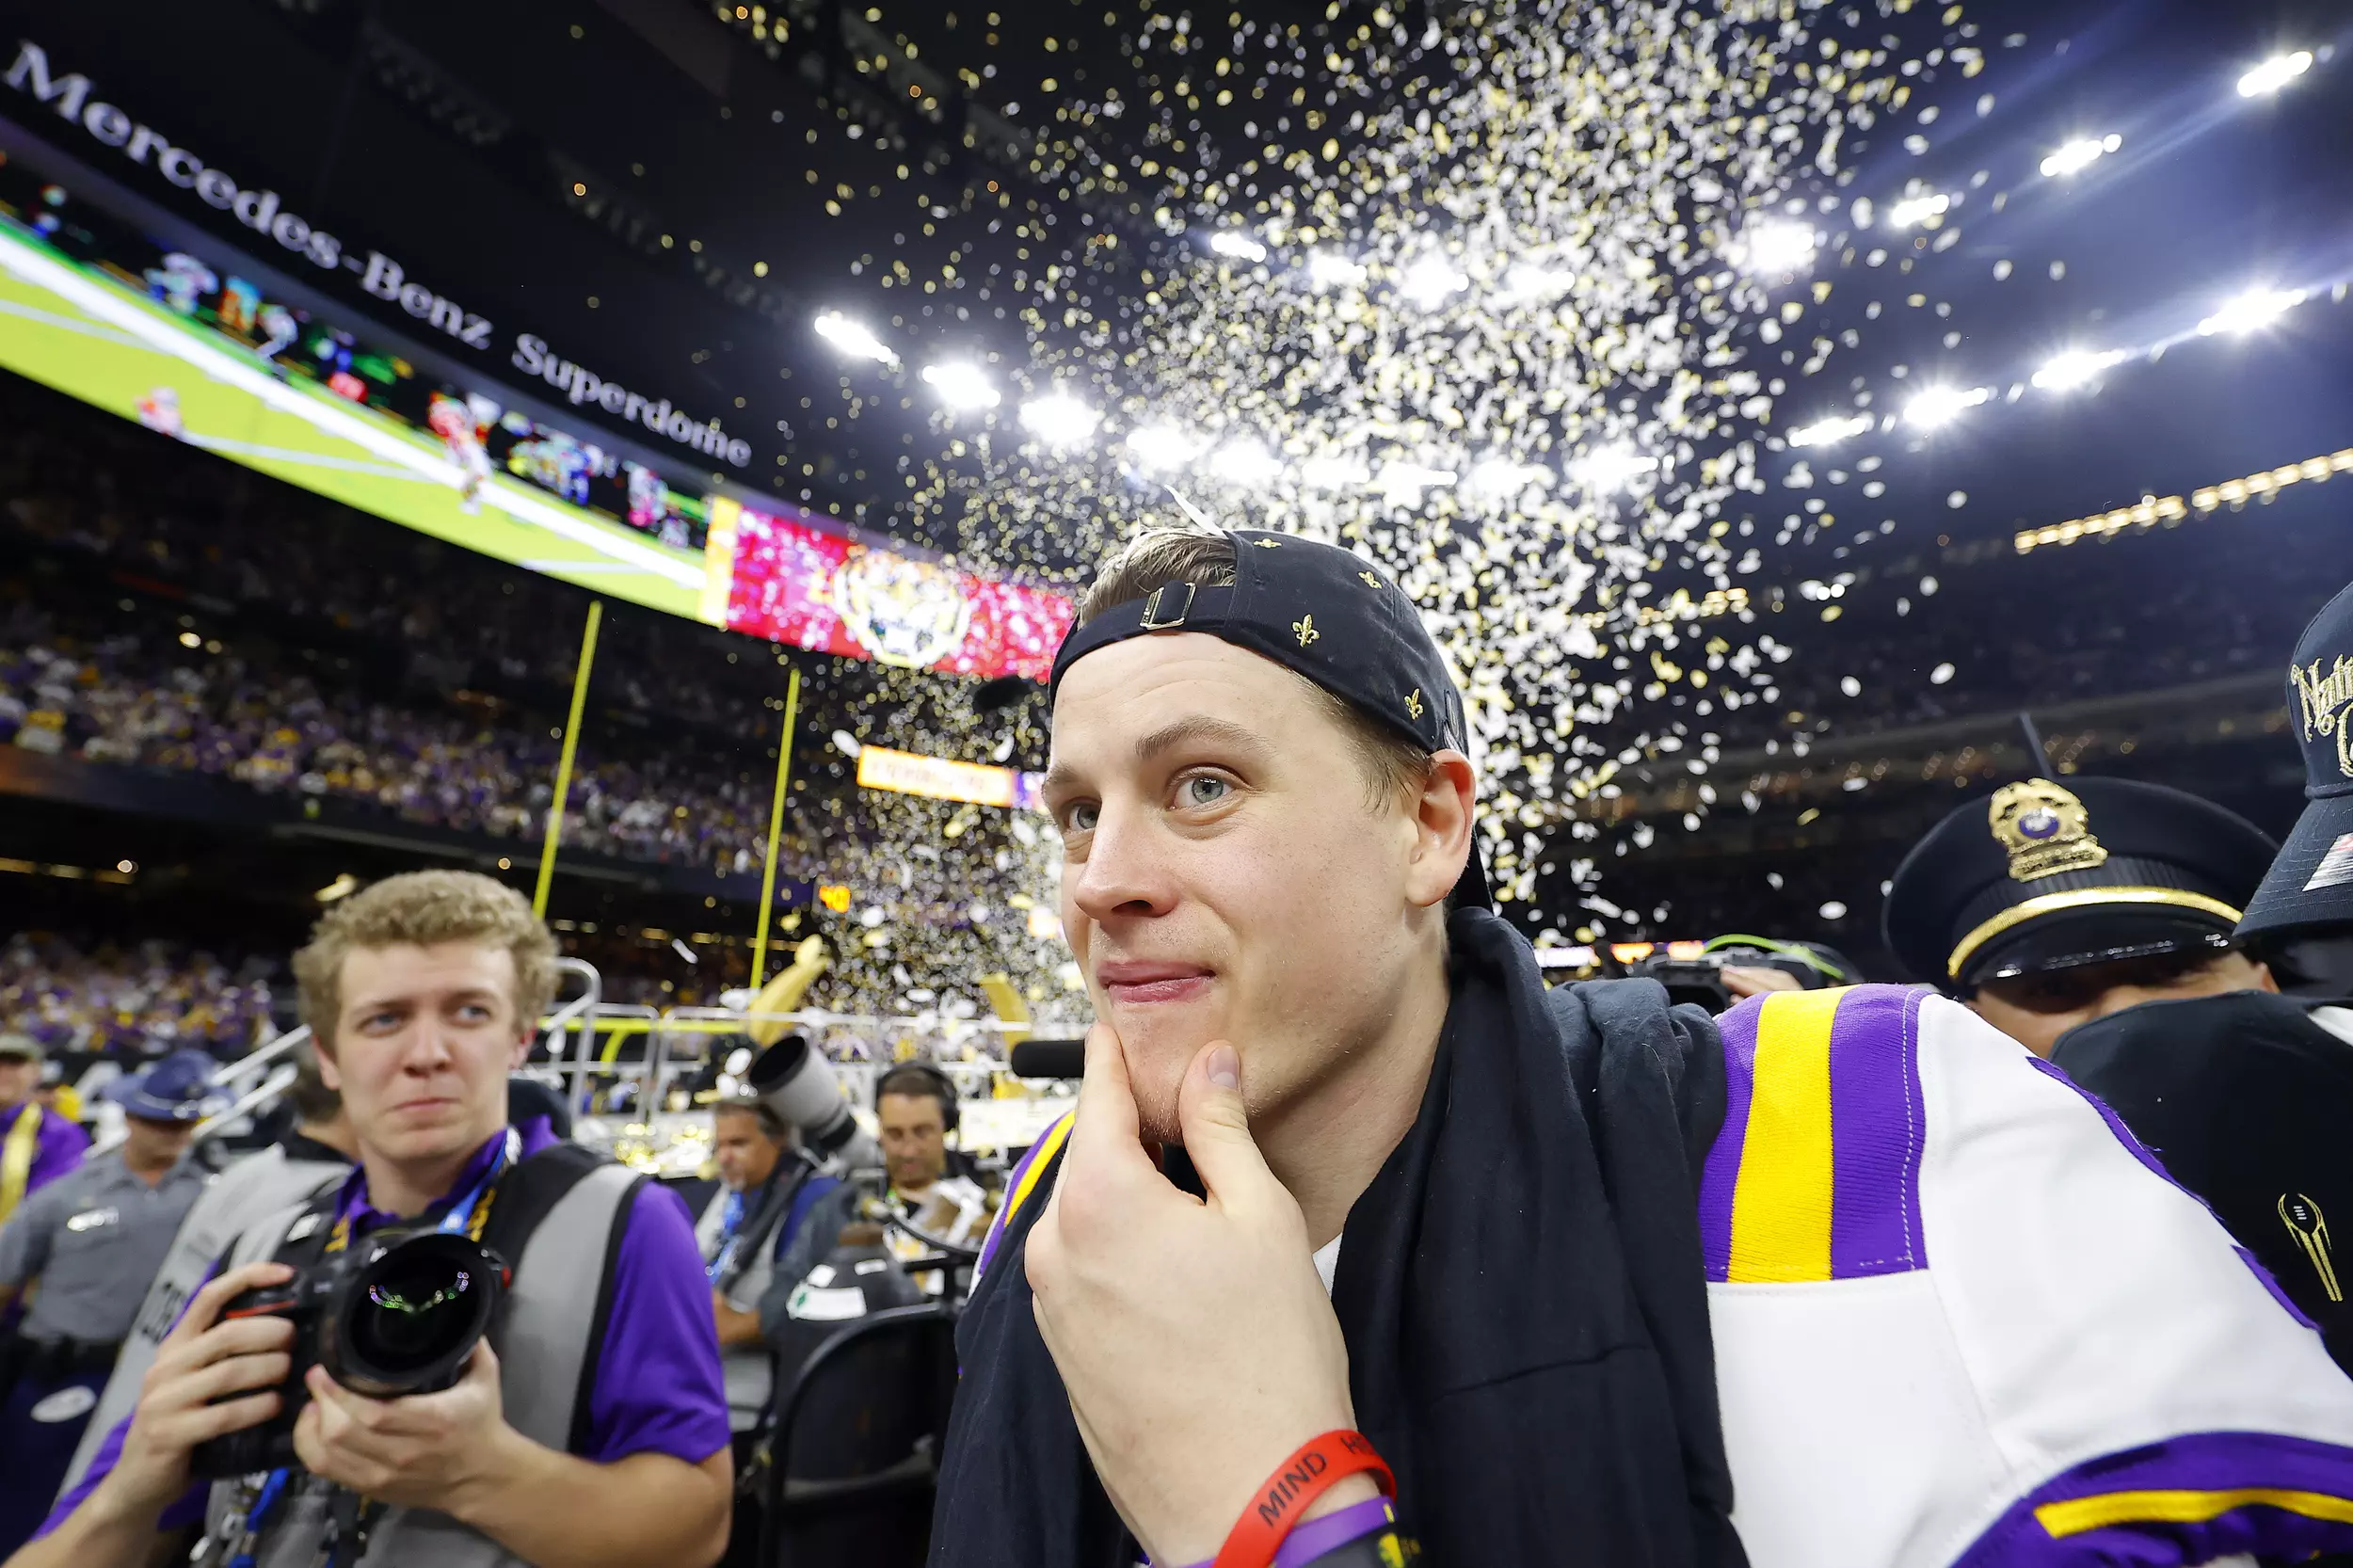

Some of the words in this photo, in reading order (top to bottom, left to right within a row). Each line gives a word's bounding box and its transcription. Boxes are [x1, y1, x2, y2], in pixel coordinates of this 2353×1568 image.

[4, 40, 494, 350] Mercedes-Benz
[511, 333, 752, 468] Superdome
[1257, 1451, 1327, 1528] MIND
